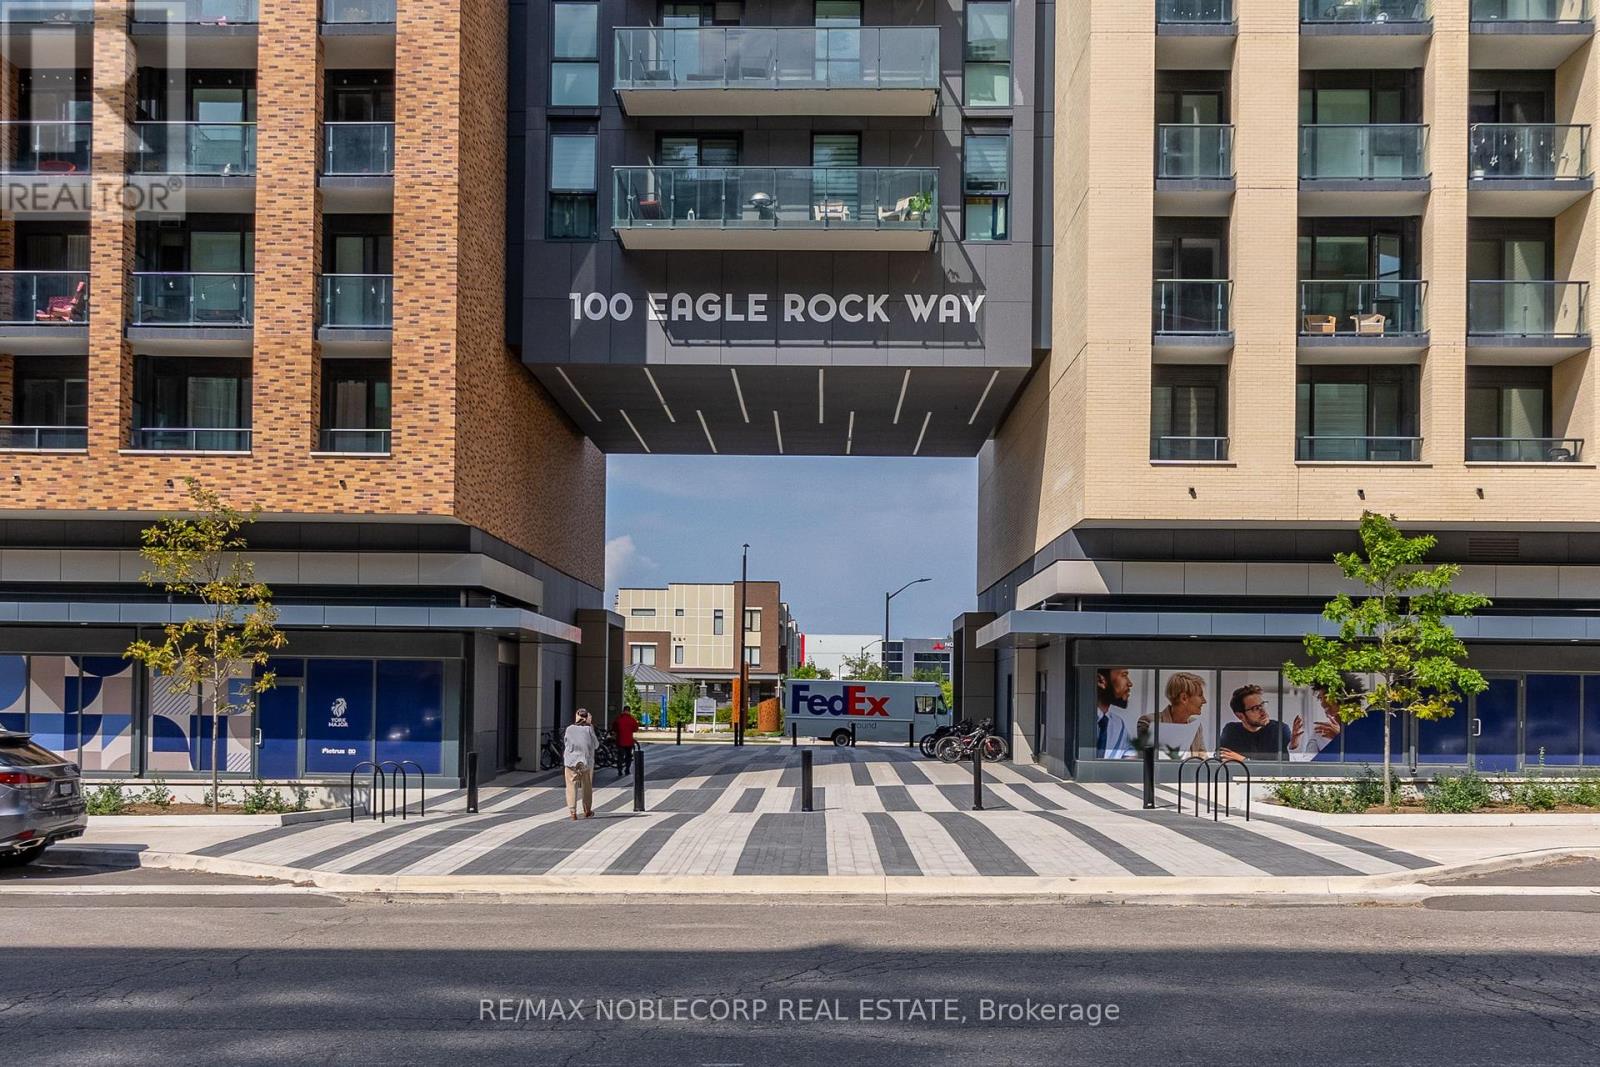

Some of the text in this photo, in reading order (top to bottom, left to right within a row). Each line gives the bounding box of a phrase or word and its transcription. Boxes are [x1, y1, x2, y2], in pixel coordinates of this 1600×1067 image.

[569, 292, 985, 323] 100 EAGLE ROCK WAY
[792, 684, 890, 716] FedEx
[848, 720, 877, 729] Gound
